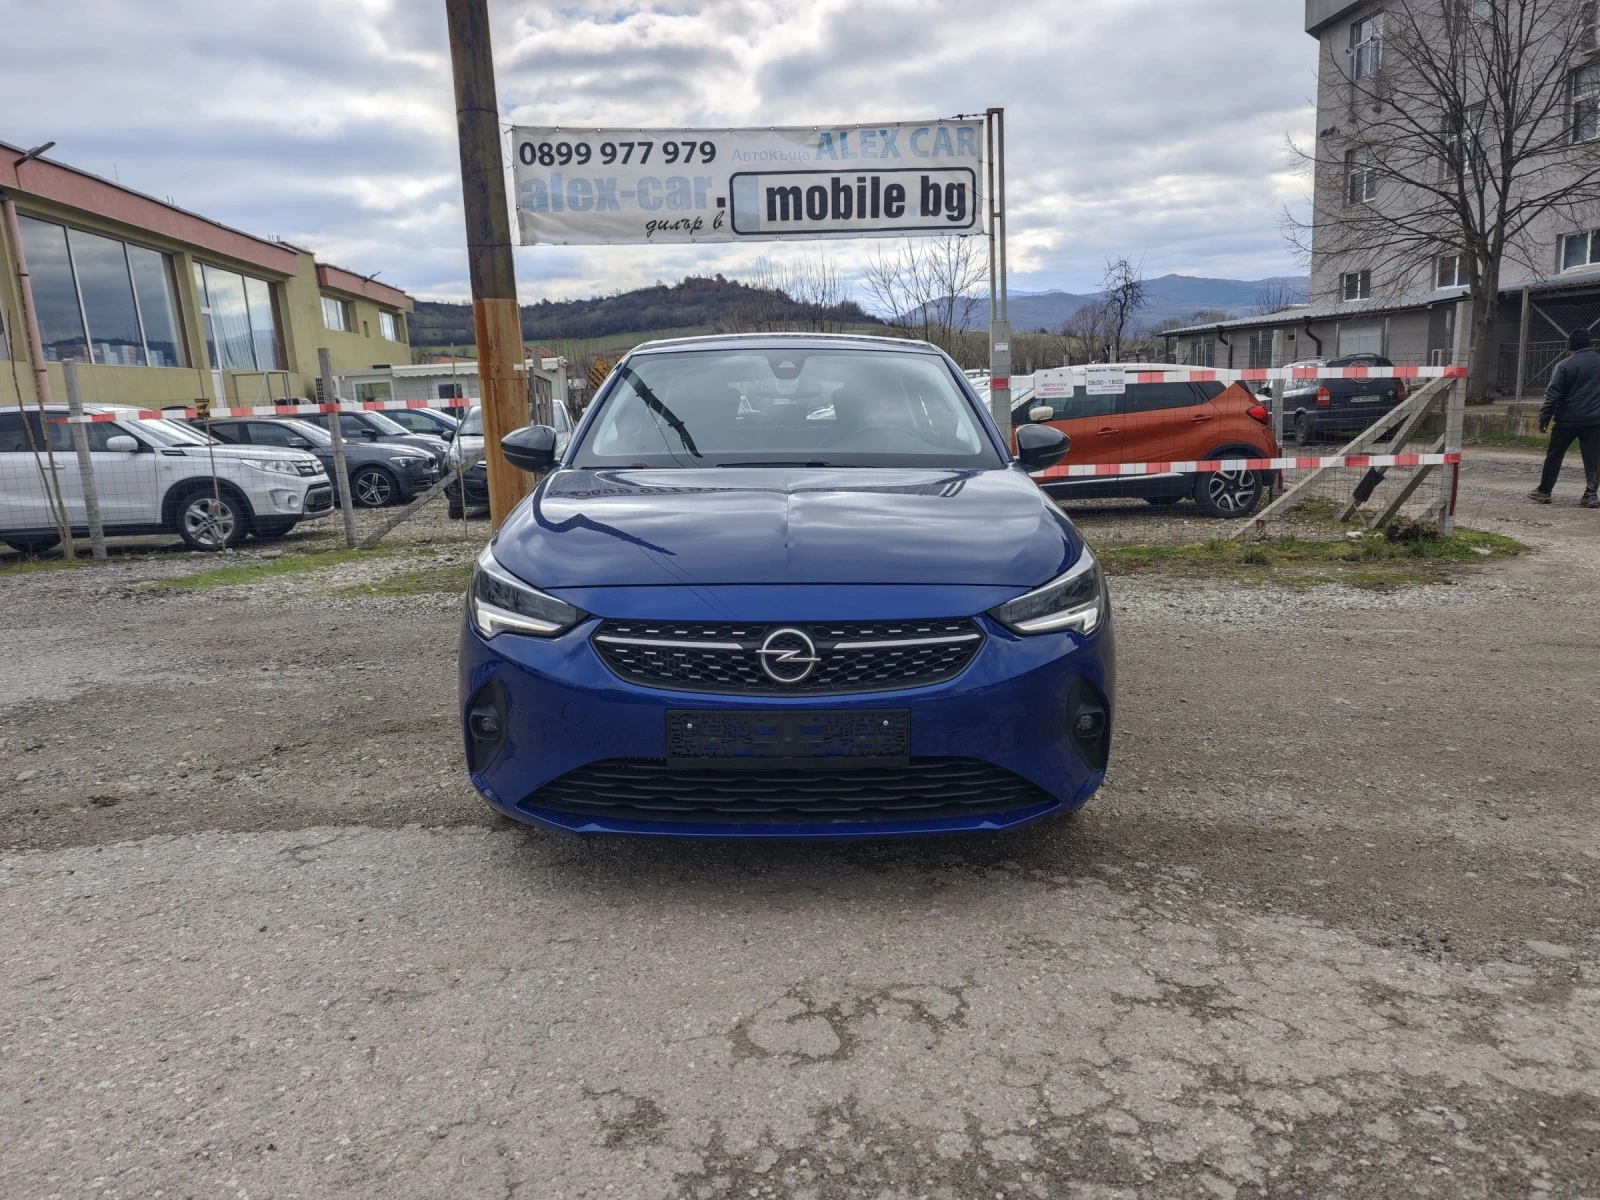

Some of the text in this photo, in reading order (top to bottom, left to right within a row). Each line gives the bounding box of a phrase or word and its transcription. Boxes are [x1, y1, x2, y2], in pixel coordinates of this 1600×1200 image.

[519, 140, 716, 166] 0899 977 979
[815, 126, 977, 161] ALEX CAR
[646, 215, 704, 238] дилър
